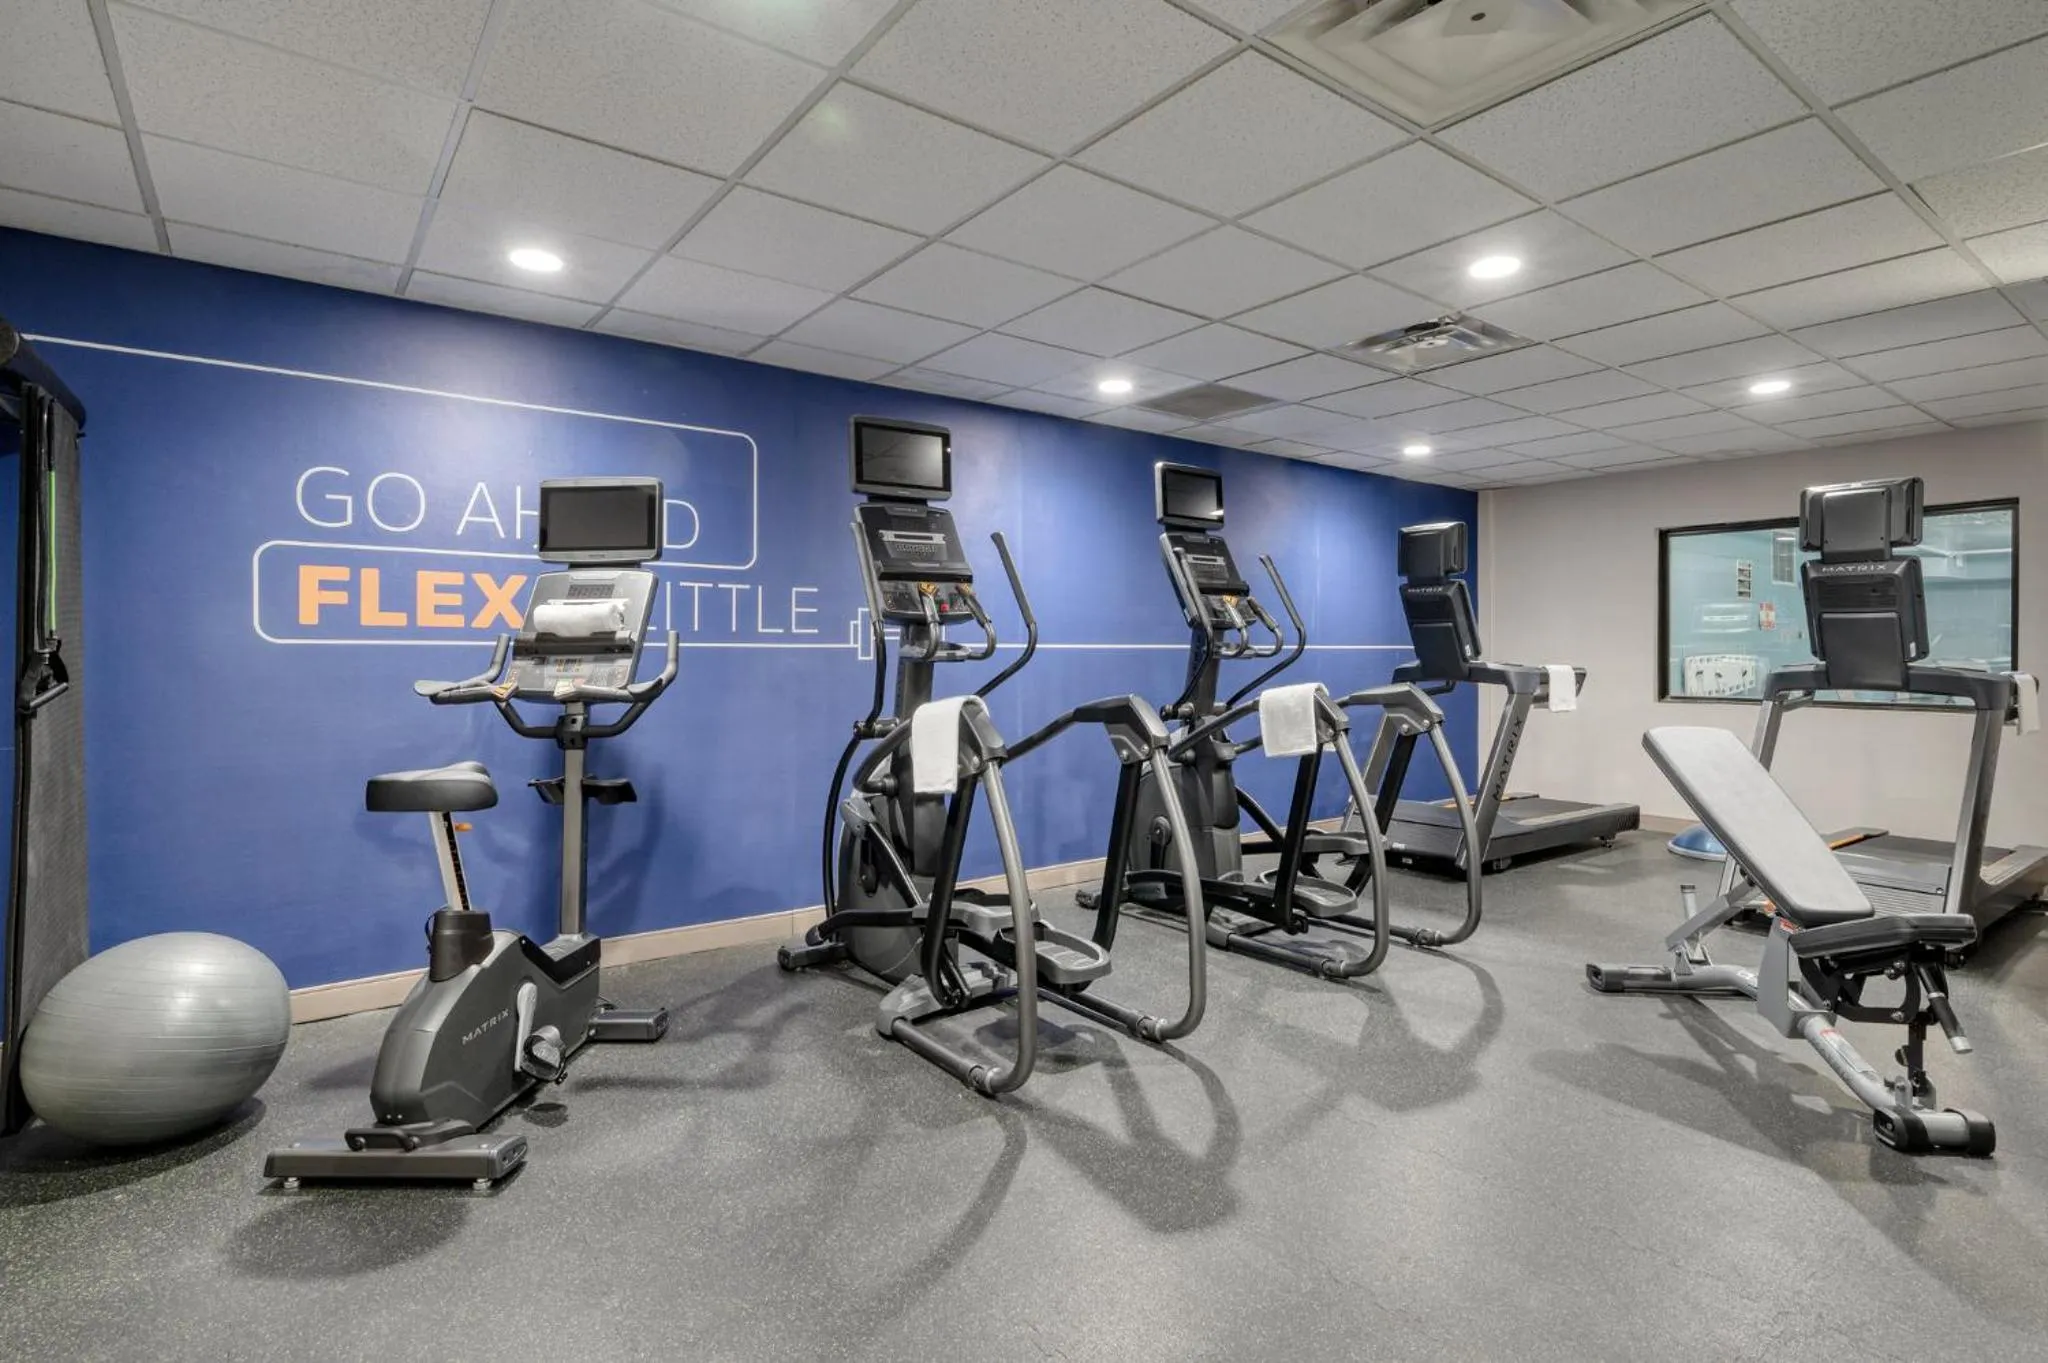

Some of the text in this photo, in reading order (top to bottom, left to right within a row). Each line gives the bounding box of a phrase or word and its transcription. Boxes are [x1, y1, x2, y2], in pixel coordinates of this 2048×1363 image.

[296, 466, 700, 549] GO AHD
[298, 564, 819, 633] FLEX ITTLE
[1822, 564, 1886, 573] MATRIX
[1492, 716, 1522, 801] MATRIX
[461, 1008, 509, 1045] MATRIX
